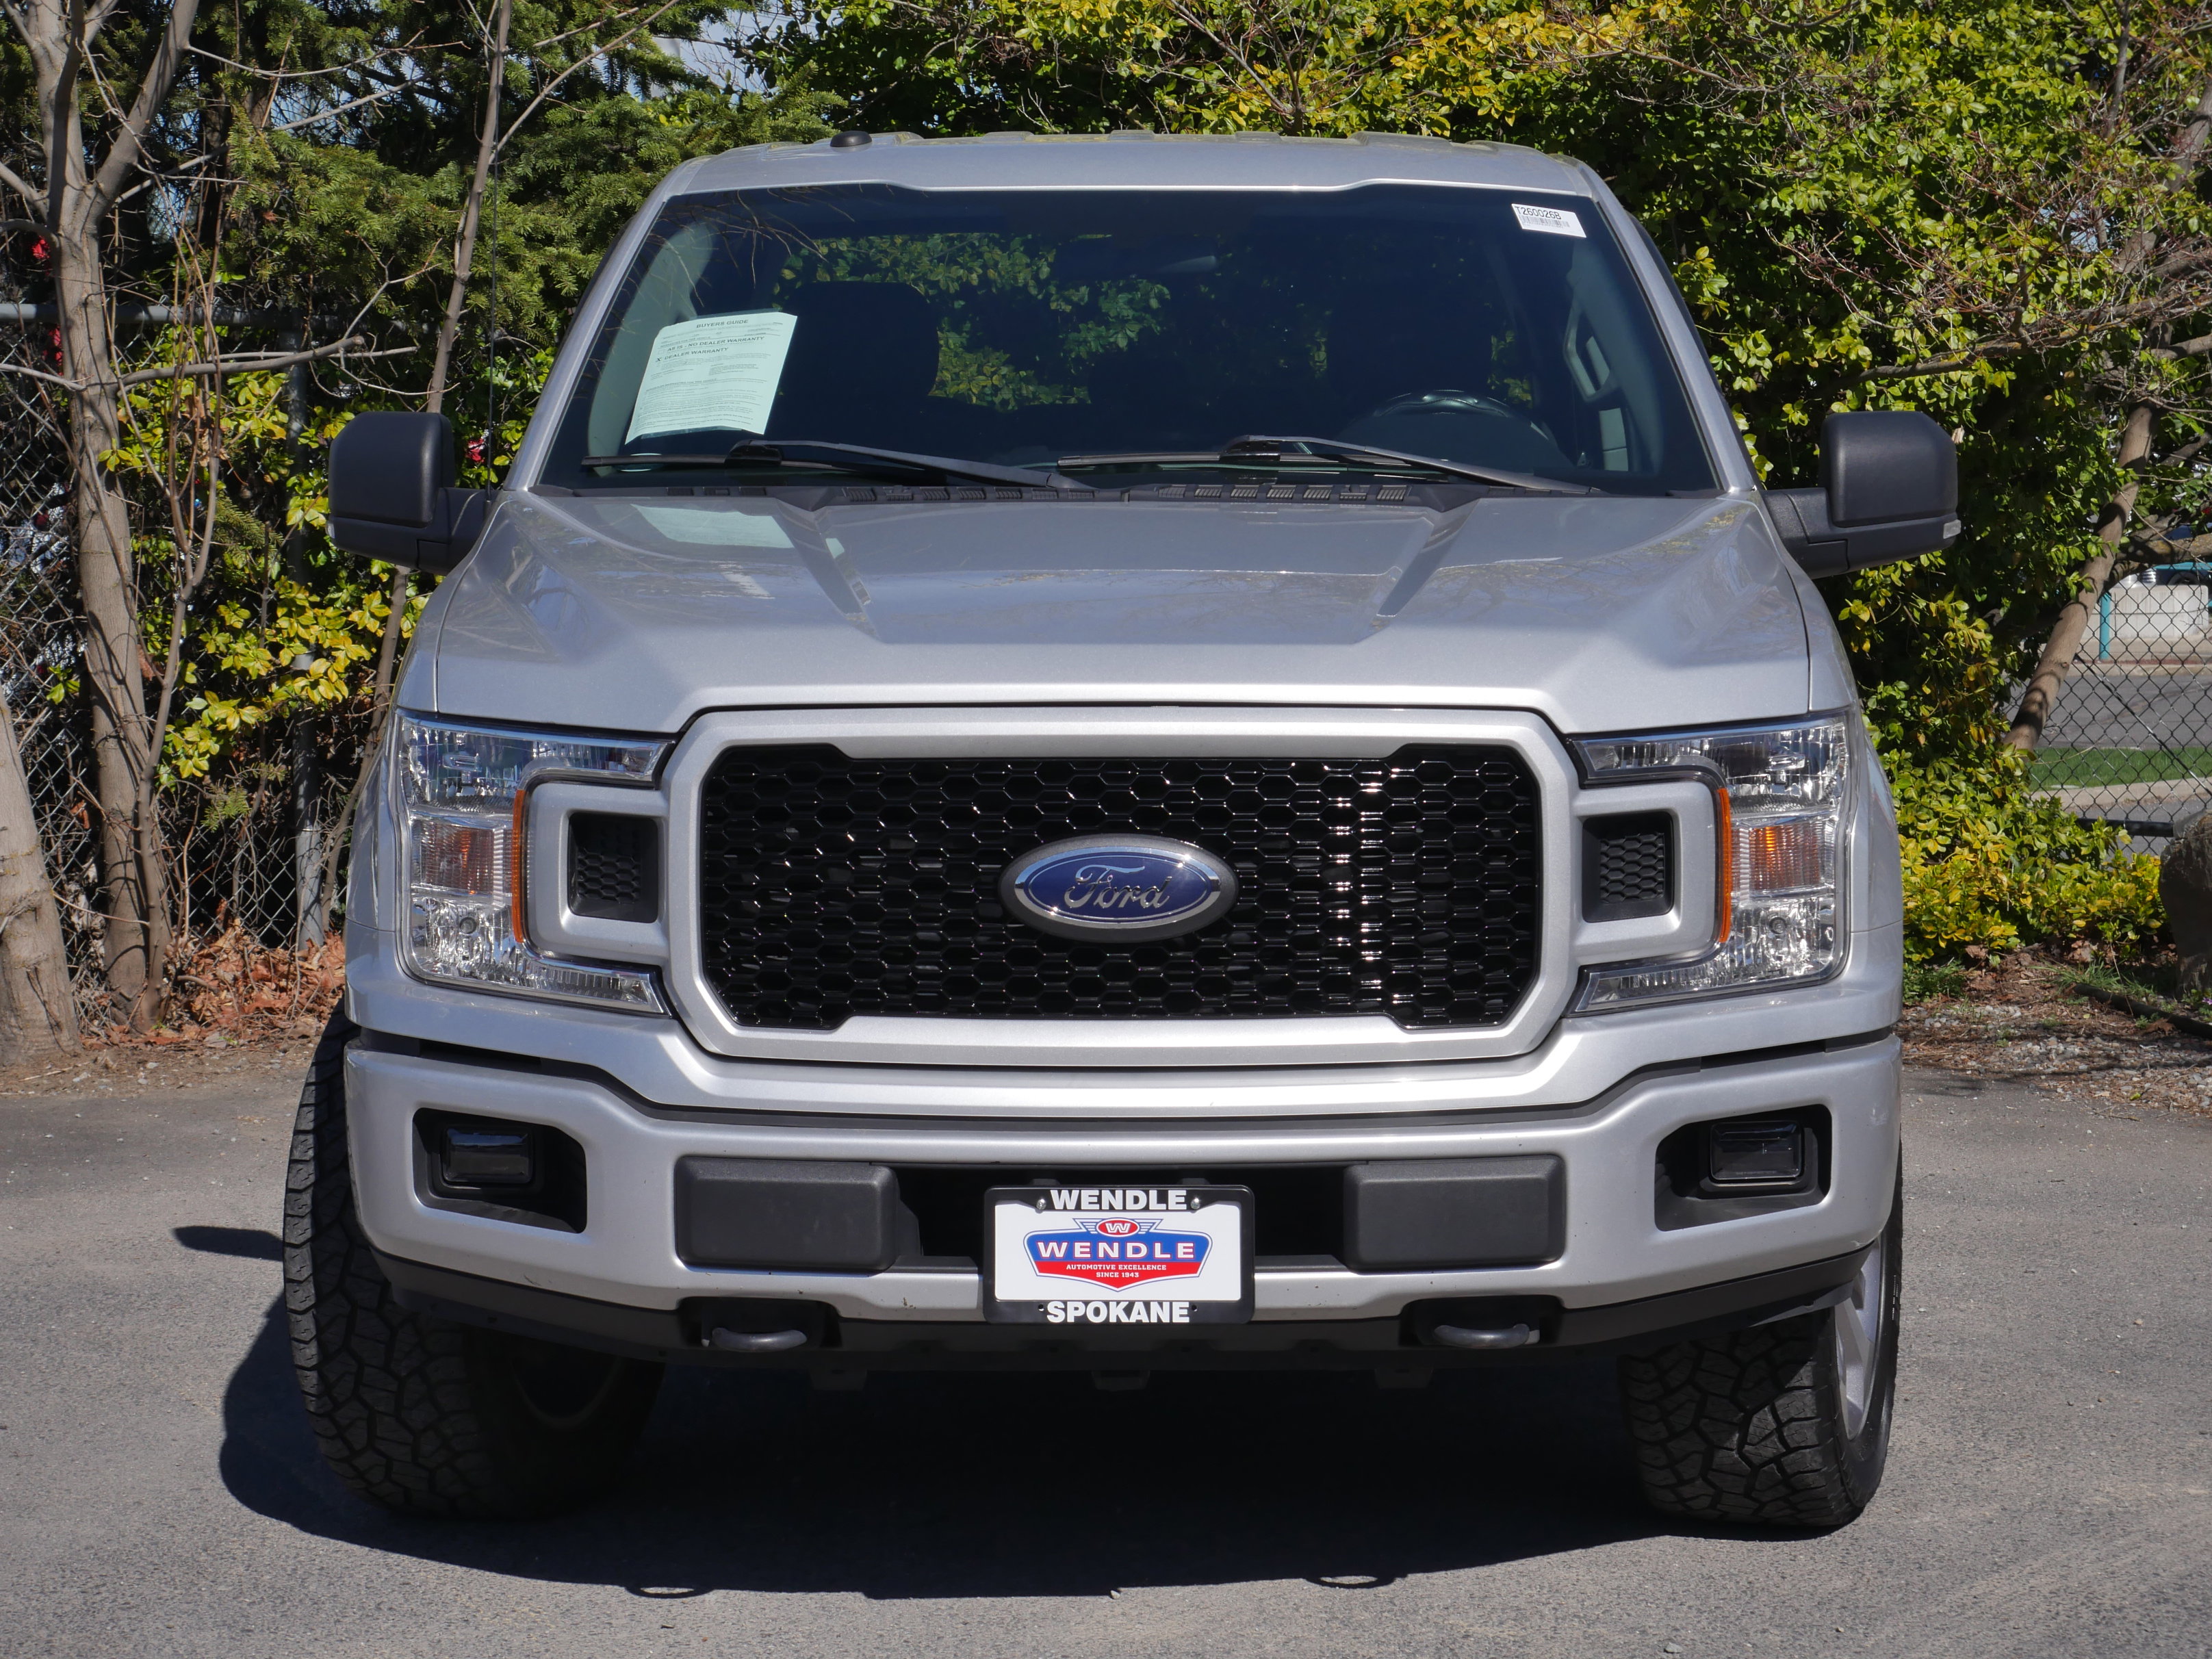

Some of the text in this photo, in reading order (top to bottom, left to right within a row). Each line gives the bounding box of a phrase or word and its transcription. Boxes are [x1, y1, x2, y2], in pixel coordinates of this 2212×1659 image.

[1515, 206, 1562, 220] T260026B
[664, 352, 690, 360] DEALER
[1064, 864, 1172, 908] Ford
[1050, 1189, 1187, 1210] WENDLE
[1036, 1242, 1195, 1259] WENDLE
[1046, 1300, 1190, 1323] SPOKANE
